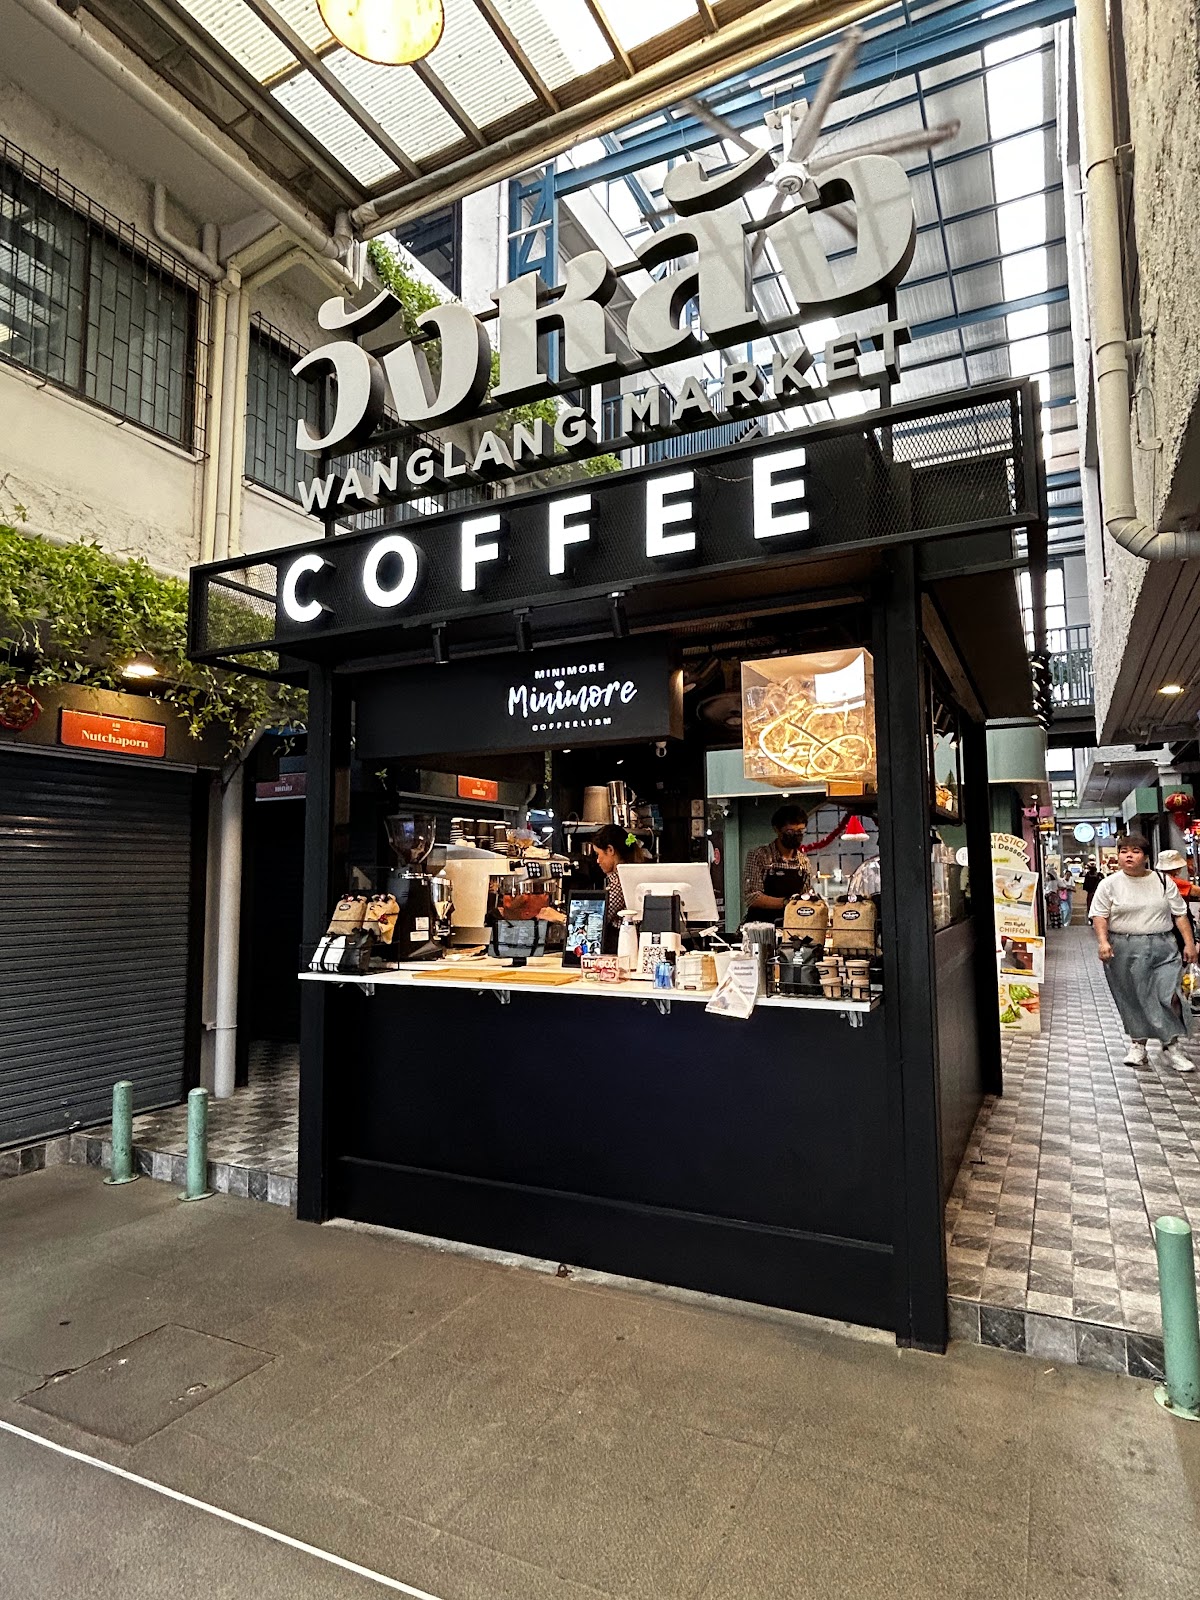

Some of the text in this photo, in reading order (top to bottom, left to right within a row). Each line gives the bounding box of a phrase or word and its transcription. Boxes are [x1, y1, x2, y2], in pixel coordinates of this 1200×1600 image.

[291, 147, 912, 453] วังหลัง
[298, 320, 910, 514] WANGLANG MARKET
[282, 447, 811, 623] COFFEE
[534, 662, 605, 680] MINIMORE
[508, 680, 638, 718] Minimore
[81, 729, 149, 749] Nutchaporn
[998, 843, 1028, 862] Dessert
[999, 926, 1031, 934] CHIFFON
[583, 959, 597, 968] TIP
